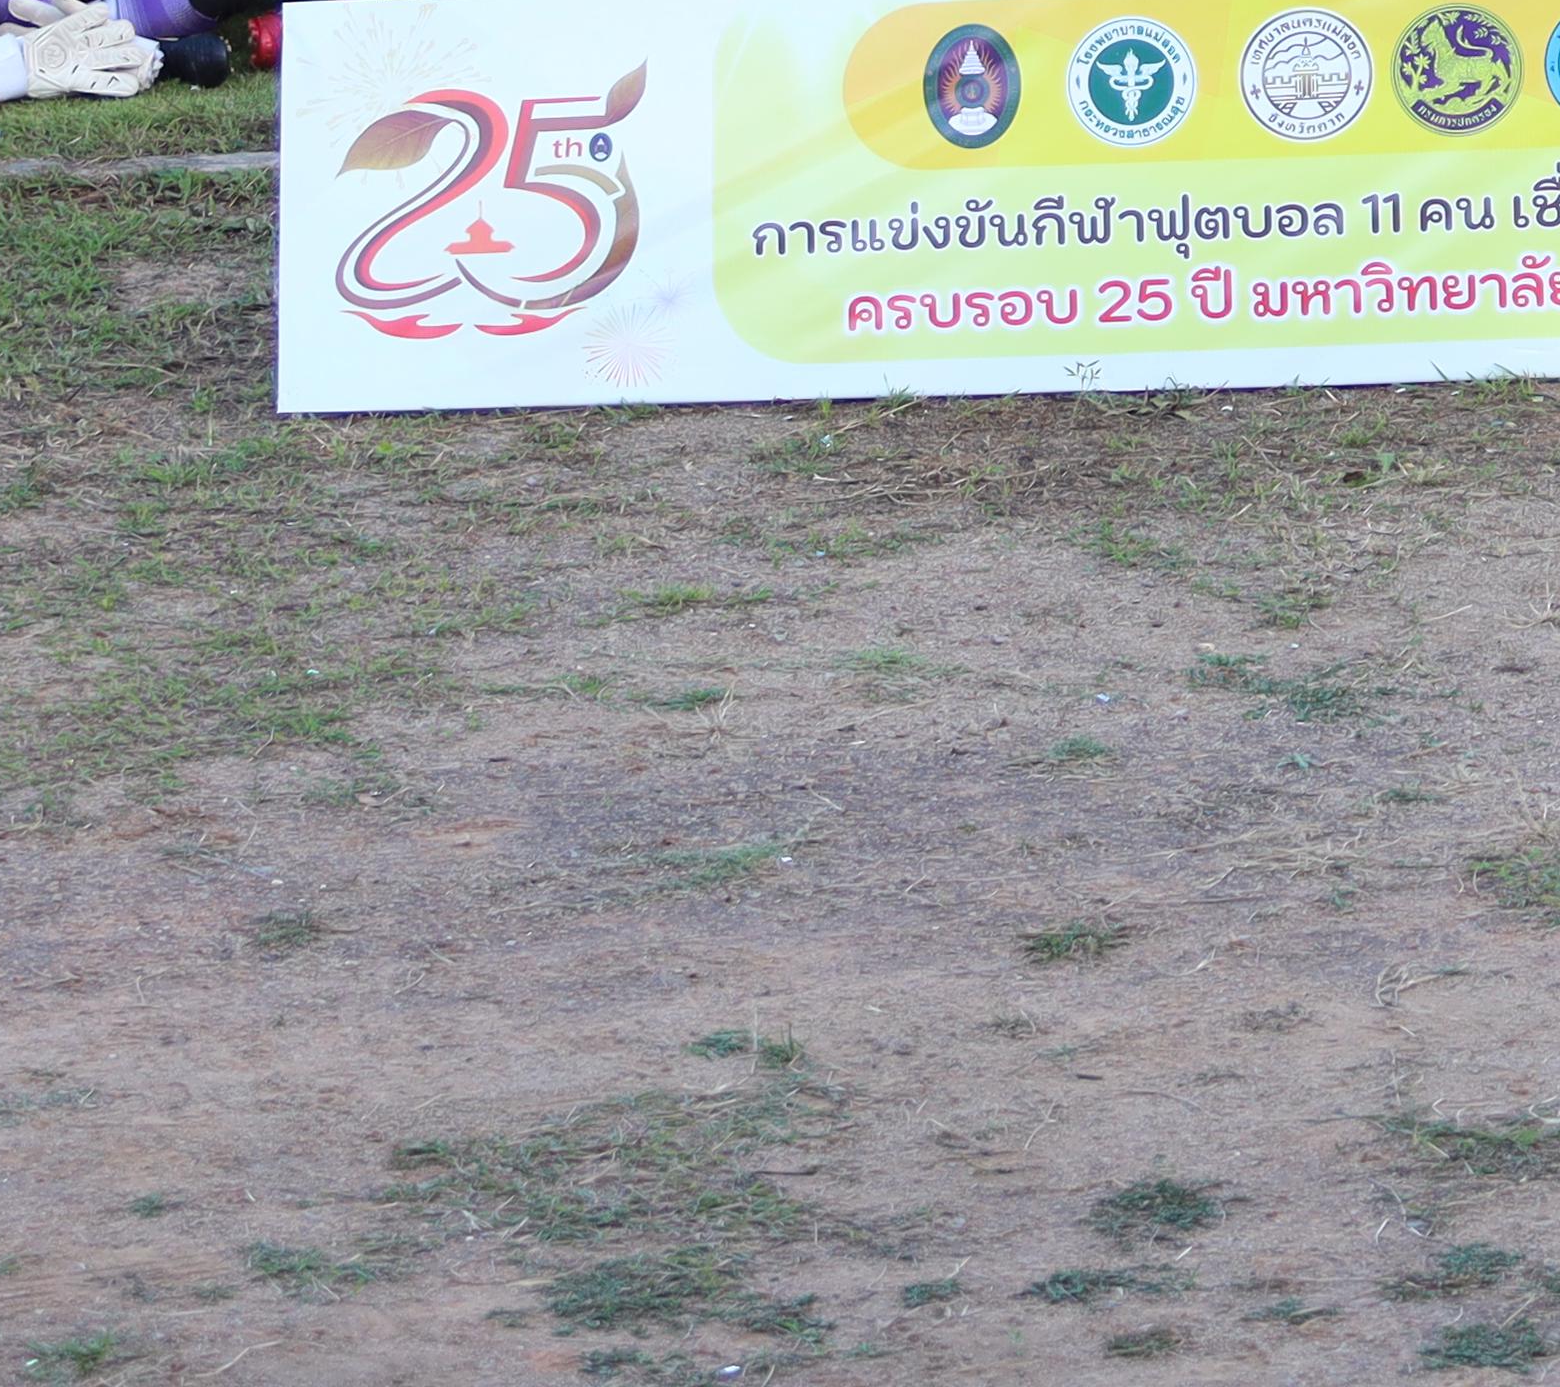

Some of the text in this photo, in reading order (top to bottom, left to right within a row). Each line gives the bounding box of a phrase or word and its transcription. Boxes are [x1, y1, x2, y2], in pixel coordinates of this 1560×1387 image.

[552, 137, 584, 159] th
[1416, 103, 1499, 128] กรมการปกครอง
[335, 77, 645, 310] 25
[752, 193, 1345, 259] การแข่งขันกีฬาฟุตบอล
[1361, 192, 1402, 235] 11
[1419, 196, 1495, 232] คน
[848, 287, 1079, 331] ครบรอบ
[1097, 278, 1174, 324] 25
[1190, 265, 1232, 320] ปี
